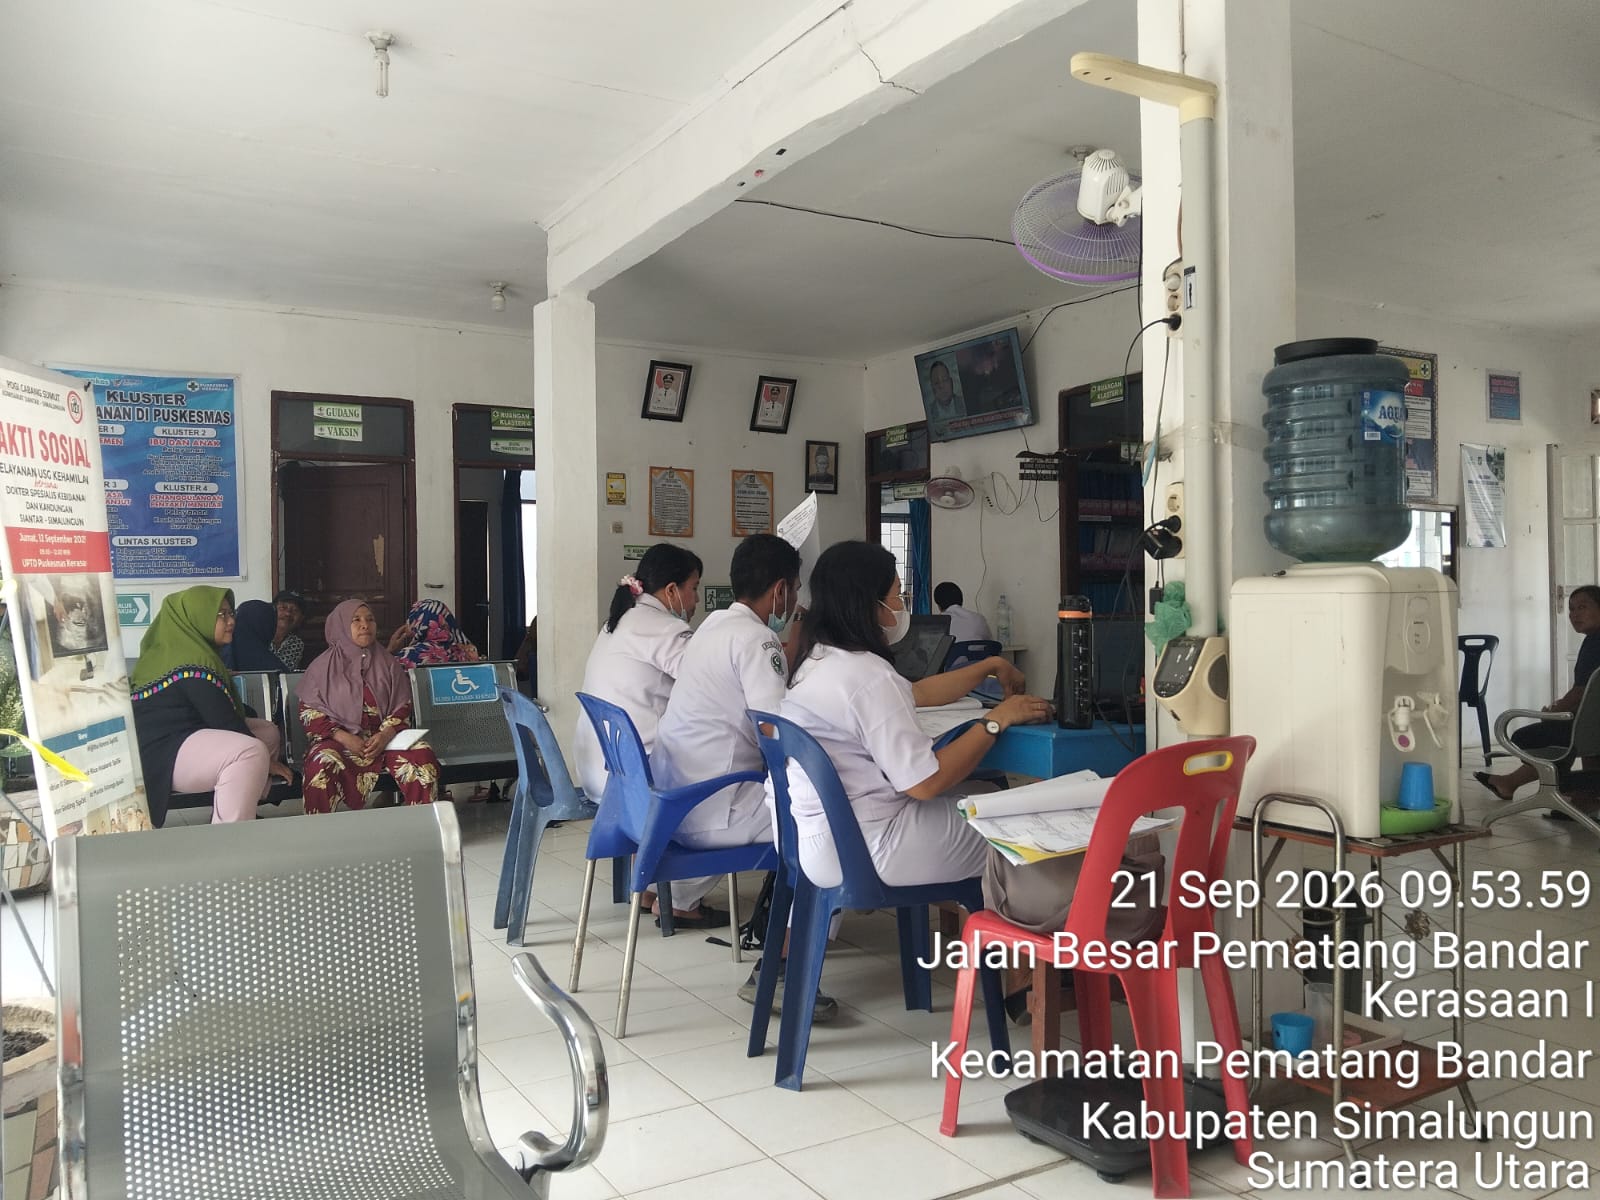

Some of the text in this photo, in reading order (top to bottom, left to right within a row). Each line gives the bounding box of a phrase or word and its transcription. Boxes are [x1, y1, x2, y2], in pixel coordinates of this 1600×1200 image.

[106, 390, 186, 406] KLUSTER
[136, 407, 149, 421] DI
[153, 408, 232, 426] PUSKESMAS
[326, 407, 360, 418] GUDANG
[162, 428, 199, 436] KLUSTER
[327, 426, 359, 437] VAKSIN
[149, 438, 221, 448] IBU DAN ANAK
[39, 429, 91, 468] SOSIAL
[6, 485, 30, 497] DOKTER
[163, 483, 208, 492] KLUSTER 4
[149, 494, 223, 502] PENANGGULANGAN
[25, 501, 38, 511] DAN
[118, 537, 192, 546] LINTAS KLUSTER
